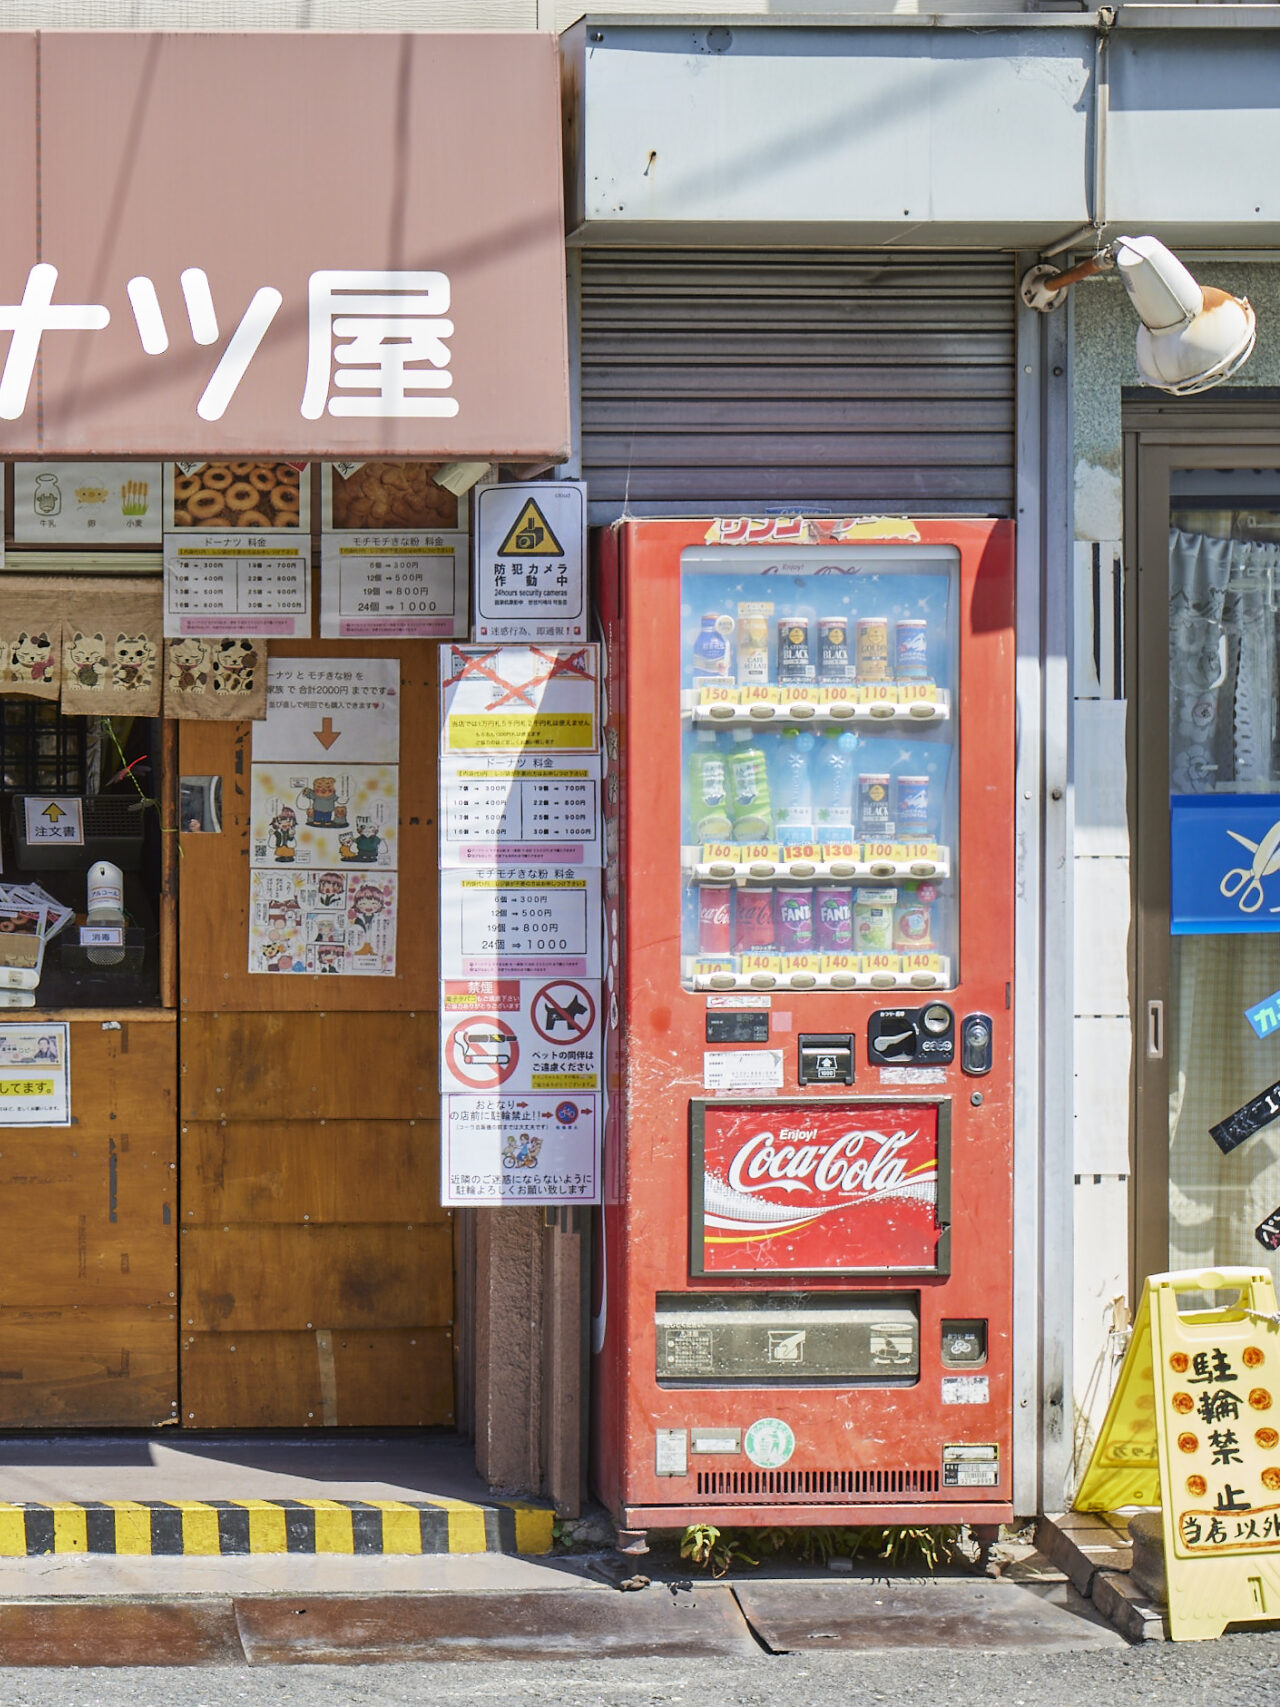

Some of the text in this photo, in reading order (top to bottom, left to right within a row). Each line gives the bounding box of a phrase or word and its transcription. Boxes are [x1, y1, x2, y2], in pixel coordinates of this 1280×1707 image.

[39, 519, 57, 529] 牛乳
[126, 519, 143, 528] 小麦
[205, 537, 267, 547] ドーナツ 料金
[352, 536, 444, 547] モチモチきな粉 料金
[494, 563, 568, 575] 防犯カメラ
[494, 575, 568, 587] 作動中
[494, 588, 568, 598] 24hours security cameras
[783, 649, 809, 659] BLACK
[823, 650, 849, 659] BLACK
[297, 672, 364, 681] と モチきな粉 を
[288, 686, 387, 695] で 合計2000円 までです
[487, 758, 554, 768] ドーナツ 料金
[863, 807, 889, 817] BLACK
[34, 825, 76, 838] 注文書
[476, 869, 575, 880] モチモチきな粉 料金
[91, 888, 120, 898] アルコール
[520, 895, 548, 903] 300円
[521, 909, 552, 918] 500円
[781, 905, 811, 922] FANT
[820, 905, 851, 922] FANT
[523, 923, 559, 933] 800円
[527, 939, 568, 950] 1000
[468, 981, 494, 994] 禁煙
[531, 1051, 595, 1060] ペットの同伴は
[531, 1062, 595, 1072] ご遠慮ください
[475, 1100, 516, 1110] おとなり
[779, 1127, 819, 1141] Enjoy!
[727, 1127, 921, 1194] Coca-Cola
[450, 1174, 593, 1185] 近隣のご迷惑にならないように
[456, 1185, 588, 1195] 駐輪よろしくお願い致します
[1187, 1348, 1252, 1511] 駐輪禁止
[1183, 1517, 1280, 1545] 当店以外
